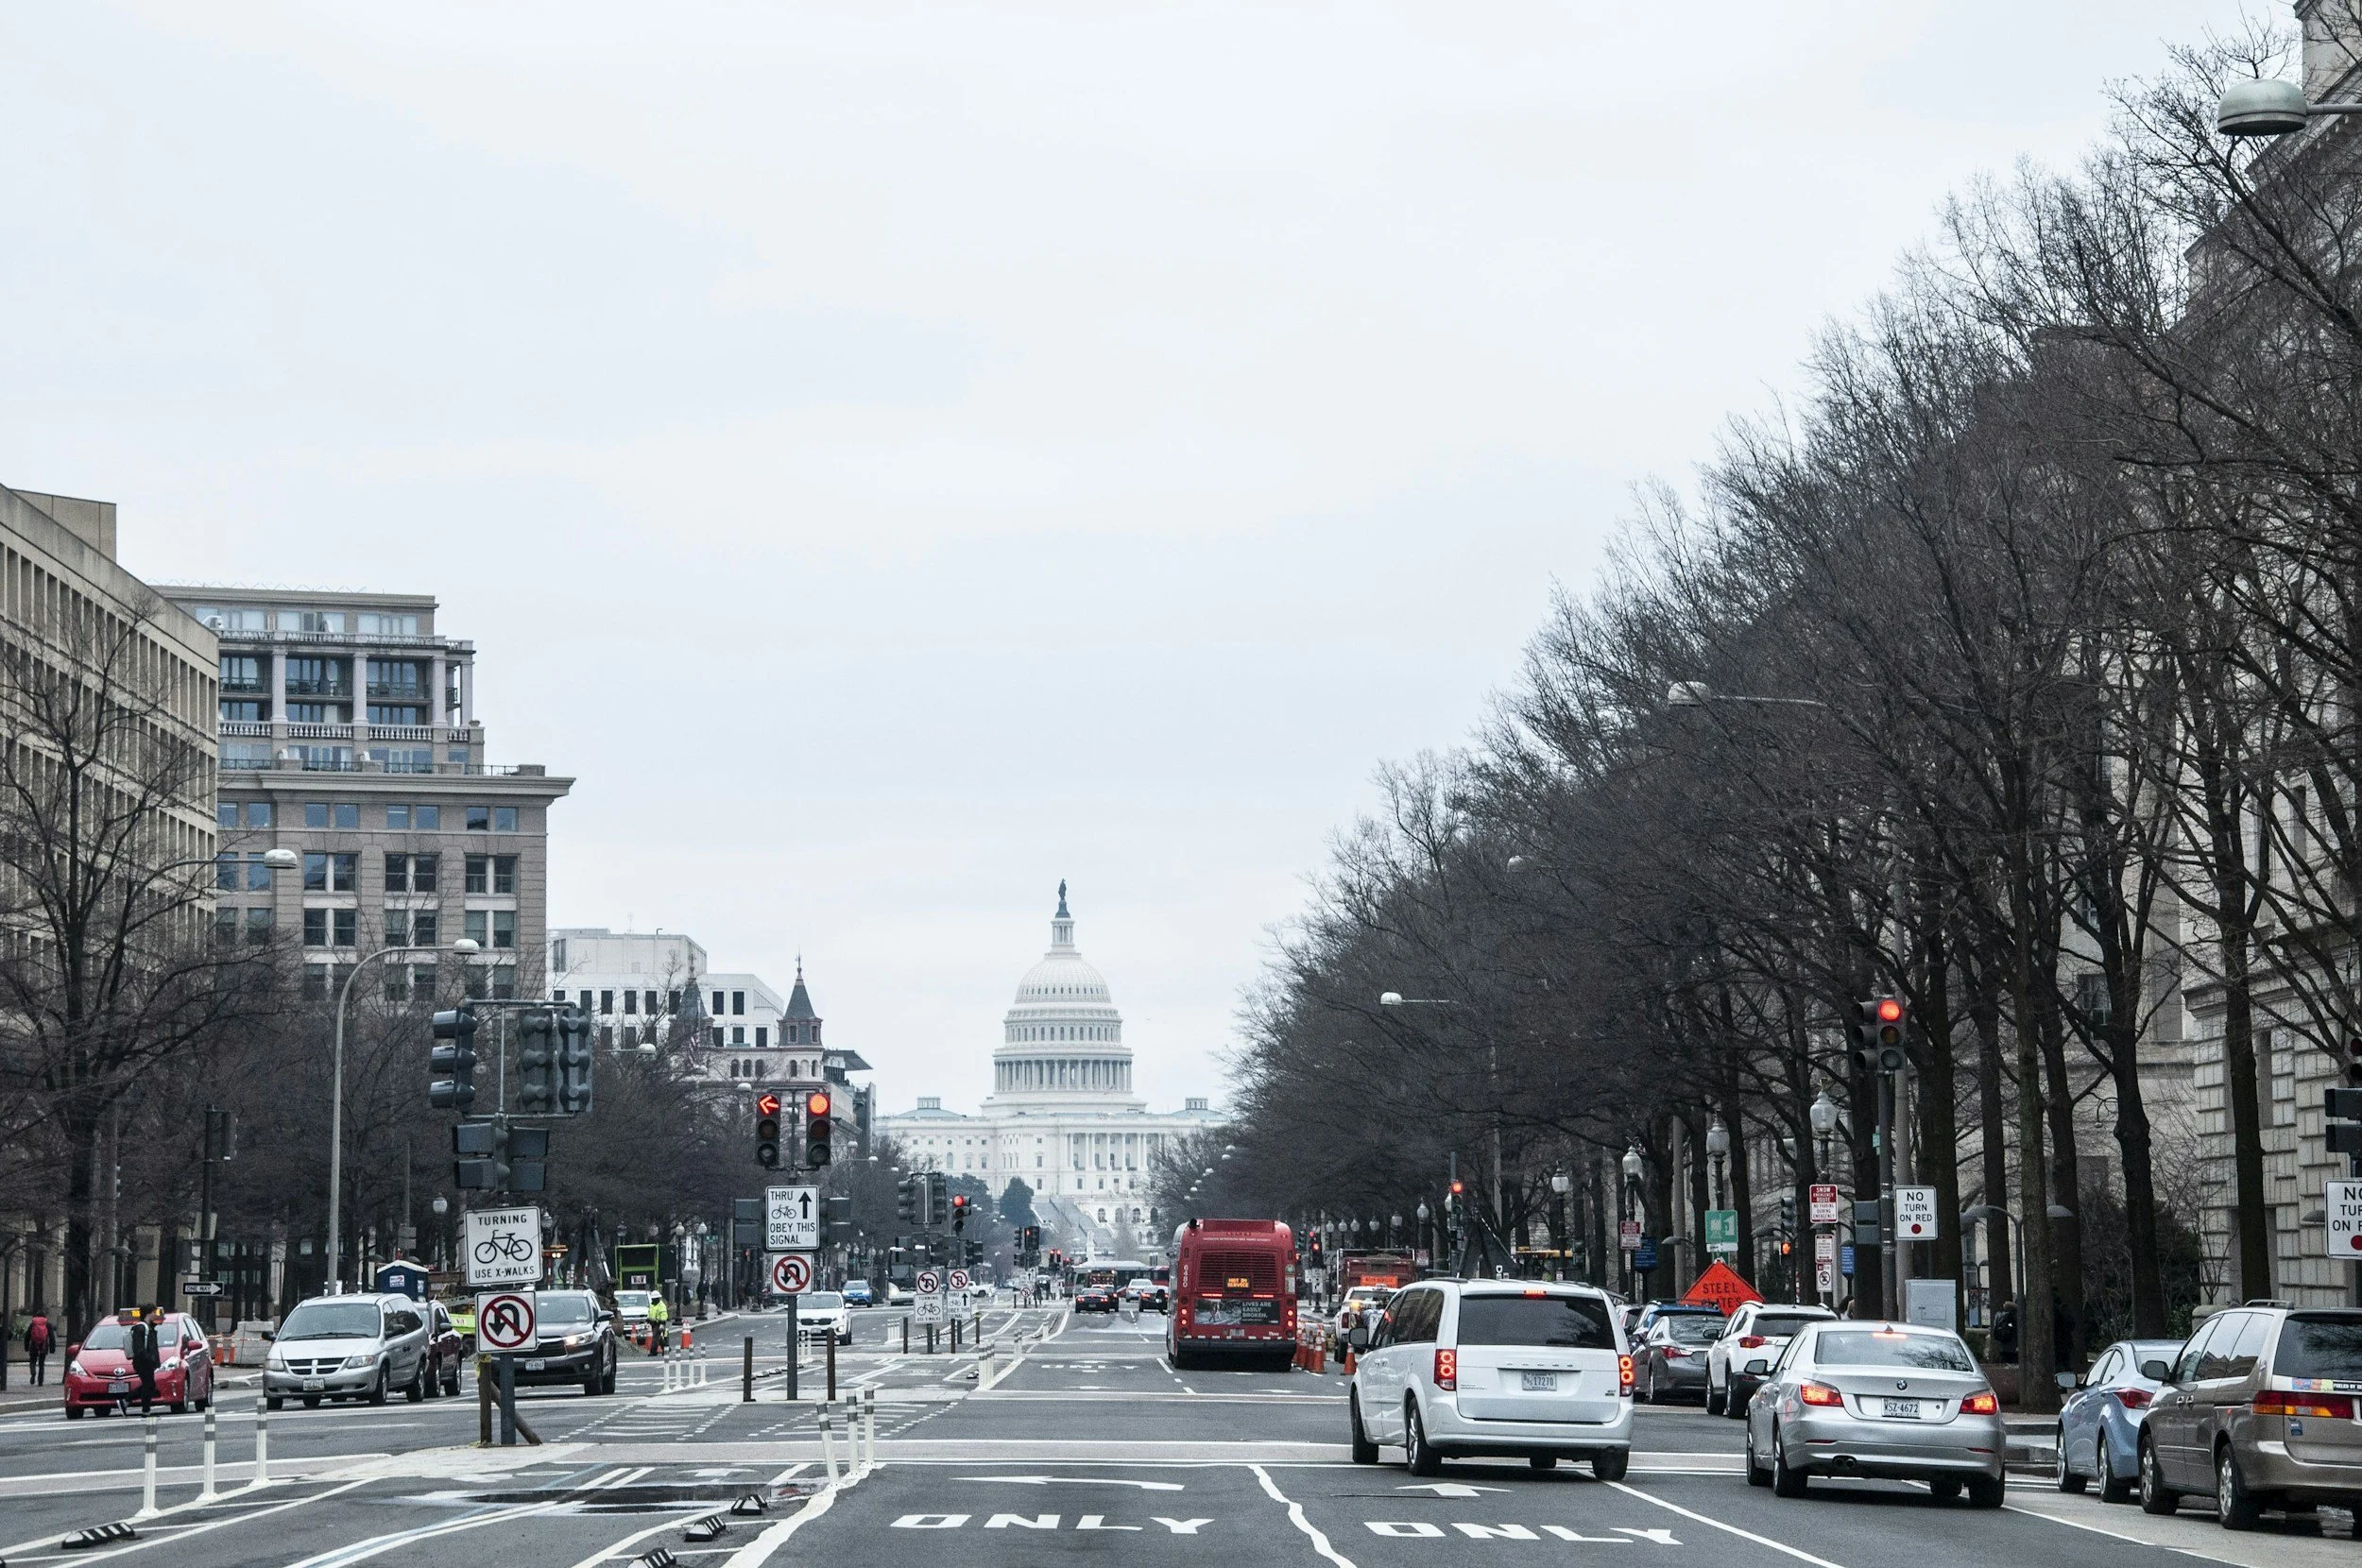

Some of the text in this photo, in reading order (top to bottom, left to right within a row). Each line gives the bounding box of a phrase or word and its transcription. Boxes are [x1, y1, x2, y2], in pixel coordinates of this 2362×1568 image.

[770, 1190, 794, 1201] THRU
[1907, 1191, 1925, 1202] NO
[2344, 1186, 2362, 1201] N
[1904, 1203, 1927, 1212] TURN
[477, 1214, 527, 1226] TURNING
[1899, 1214, 1933, 1222] ON RED
[770, 1222, 815, 1233] OBEY THIS
[2333, 1219, 2351, 1232] ON
[770, 1235, 801, 1245] SIGNAL
[475, 1266, 535, 1279] USE X-WALKS
[1703, 1283, 1738, 1294] STEEL
[890, 1513, 1216, 1534] ONLY
[1363, 1521, 1685, 1545] ONLY
